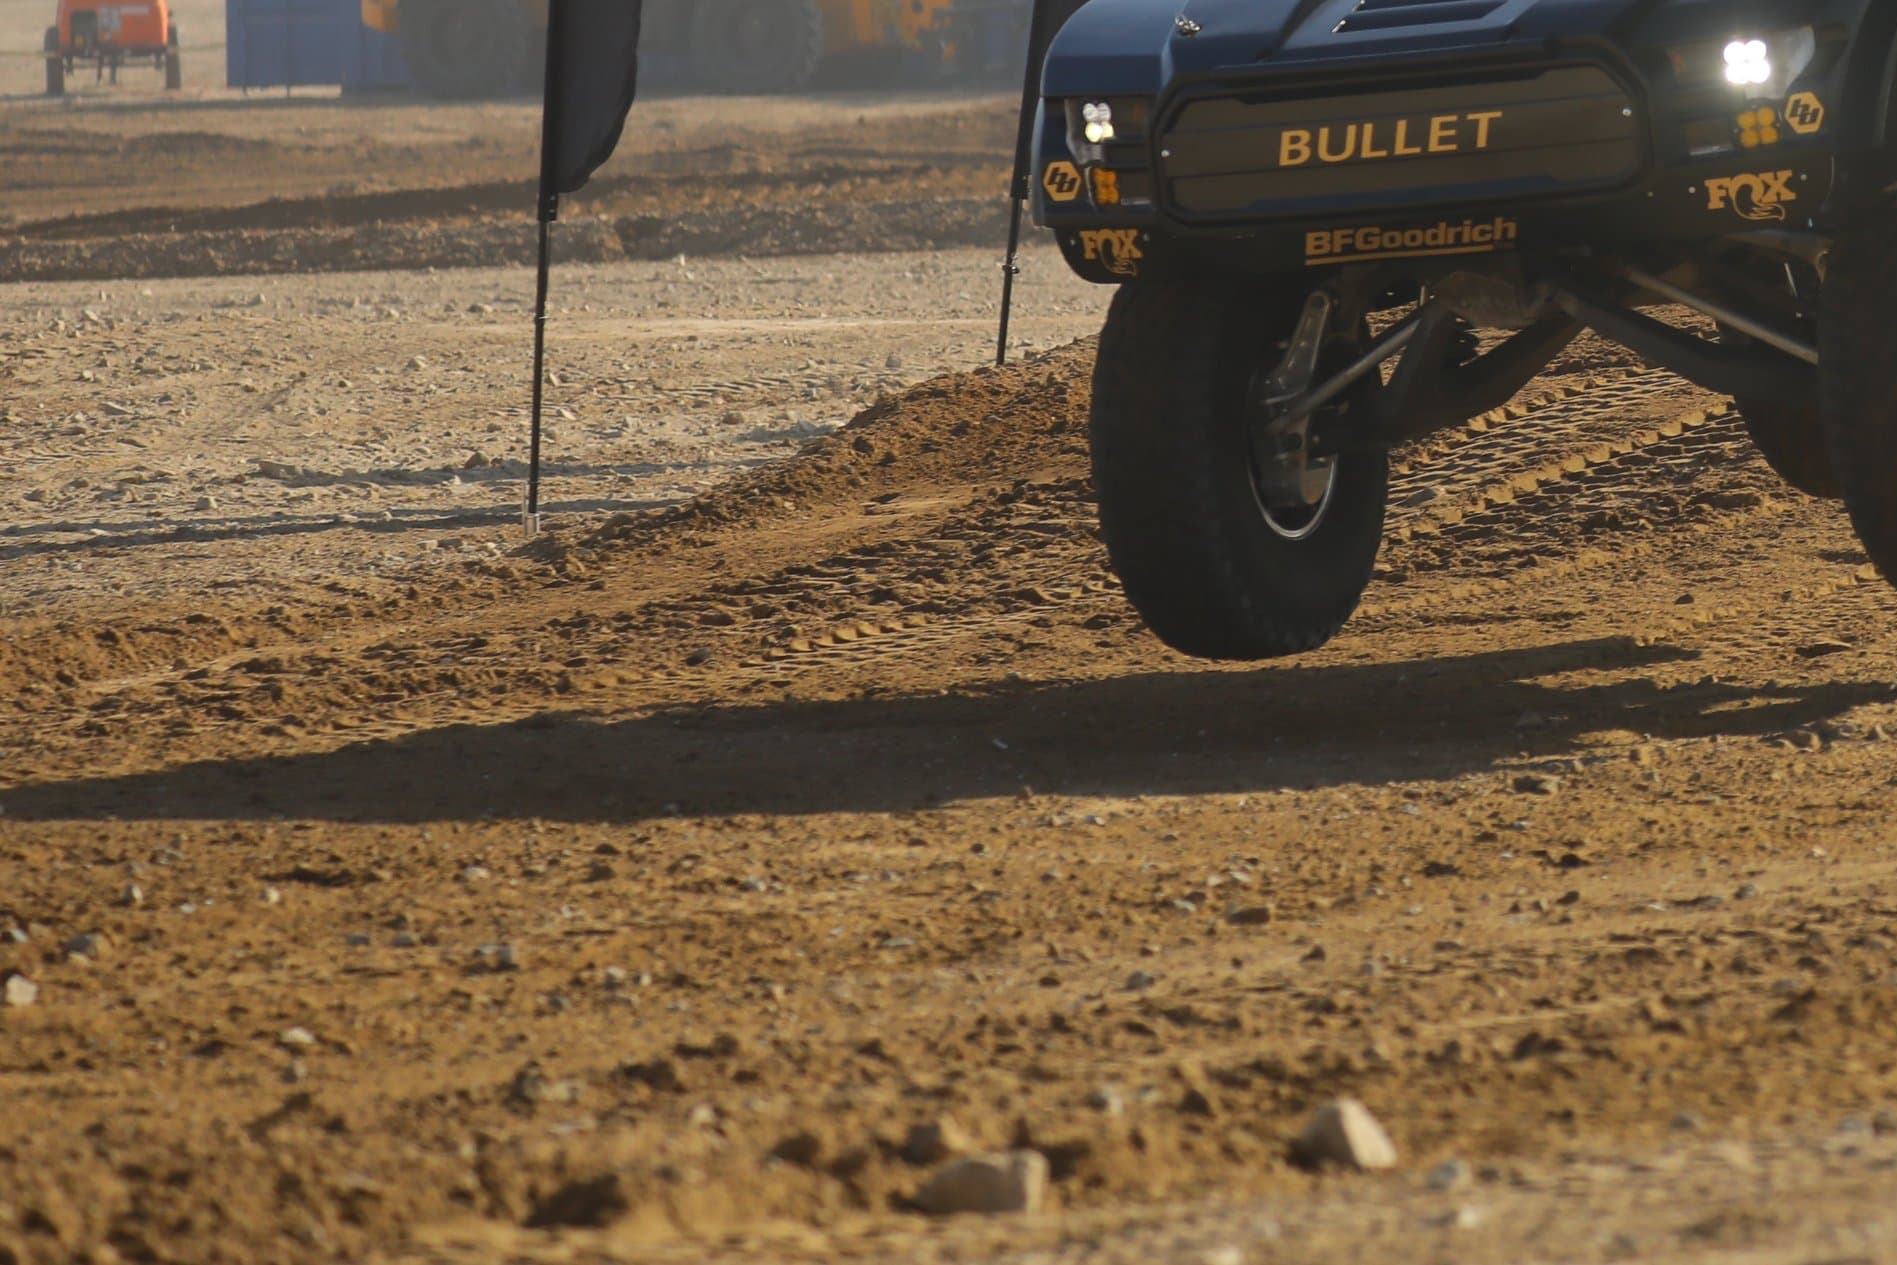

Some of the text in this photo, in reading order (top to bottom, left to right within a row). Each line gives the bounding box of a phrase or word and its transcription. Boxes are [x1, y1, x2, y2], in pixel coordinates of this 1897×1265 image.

[1279, 111, 1502, 166] BULLET
[1704, 169, 1797, 220] FOX
[1079, 228, 1143, 276] FOX
[1304, 217, 1517, 256] BFGoodrich
